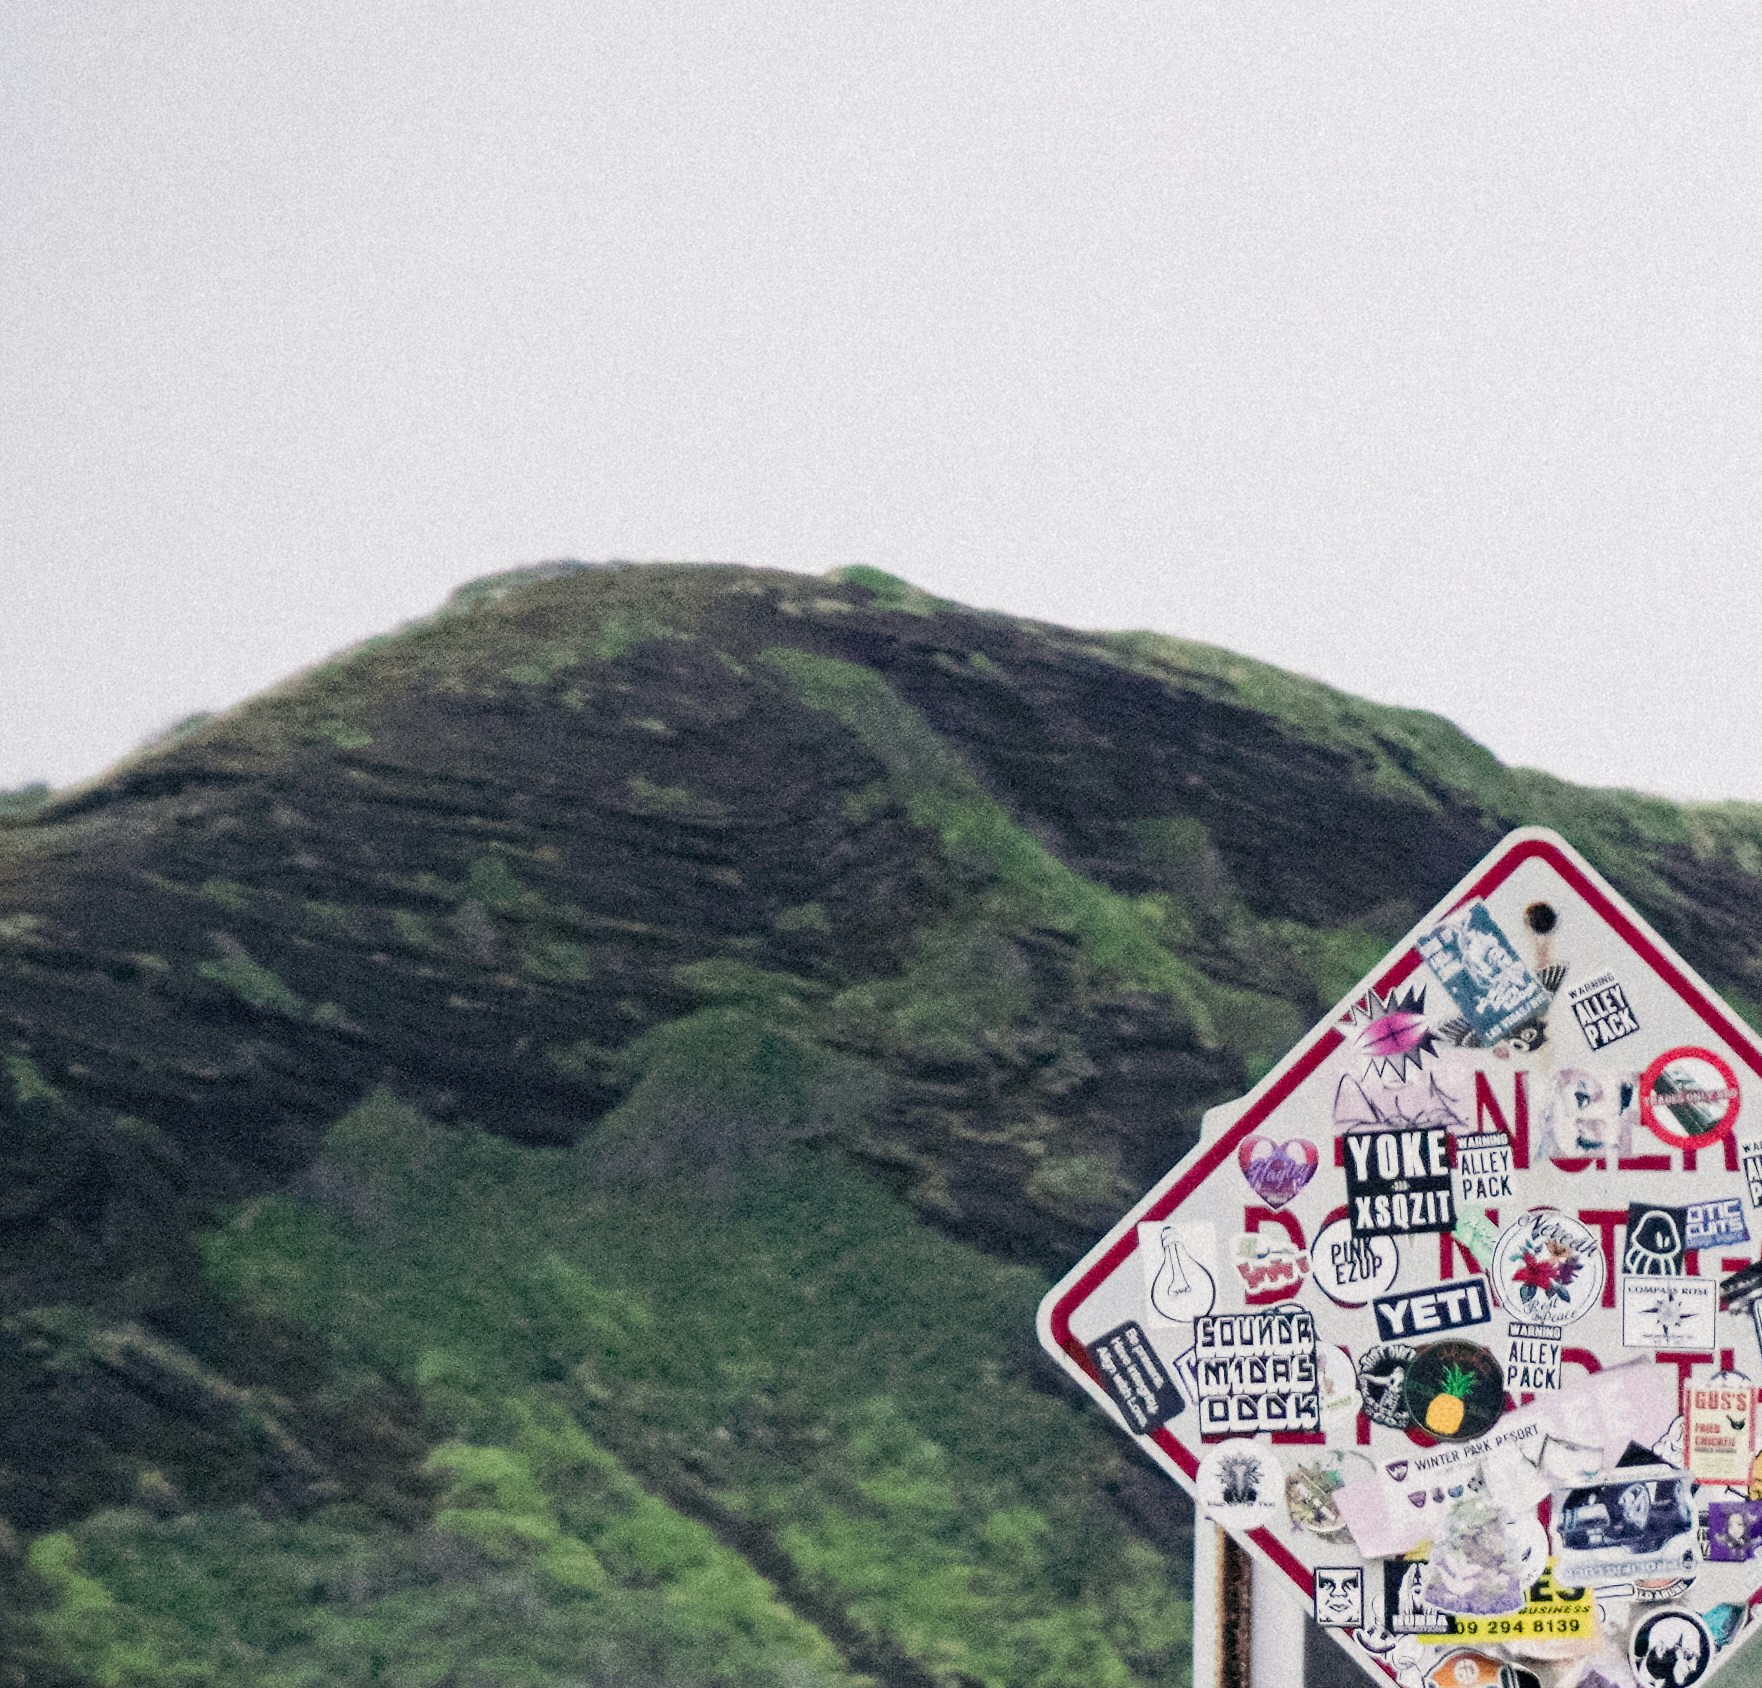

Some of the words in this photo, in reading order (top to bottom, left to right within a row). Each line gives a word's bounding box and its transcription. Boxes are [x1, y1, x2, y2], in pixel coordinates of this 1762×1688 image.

[1568, 973, 1615, 999] WARNING
[1575, 986, 1628, 1024] ALLEY
[1585, 1008, 1639, 1048] PACK
[1456, 1133, 1509, 1149] WARNING
[1348, 1129, 1450, 1182] YOKE
[1460, 1150, 1510, 1176] ALLEY
[1462, 1176, 1513, 1200] PACK
[1354, 1190, 1450, 1231] XSQZIT
[1331, 1236, 1376, 1265] PINK
[1336, 1256, 1383, 1285] EZUP
[1628, 1284, 1678, 1297] COMPASS
[1682, 1286, 1708, 1297] ROSE
[1378, 1286, 1484, 1335] YETI
[1509, 1323, 1562, 1341] WARNING
[1111, 1336, 1131, 1366] Have
[1508, 1341, 1559, 1366] ALLEY
[1507, 1366, 1560, 1390] PACK
[1694, 1391, 1747, 1412] GUS'S
[1694, 1422, 1721, 1433] FRIED
[1694, 1436, 1735, 1447] CHICKEN
[1415, 1451, 1460, 1472] WINTER
[1463, 1438, 1491, 1458] PARK
[1455, 1621, 1479, 1635] 09
[1488, 1621, 1524, 1634] 294
[1533, 1619, 1581, 1634] 8139
